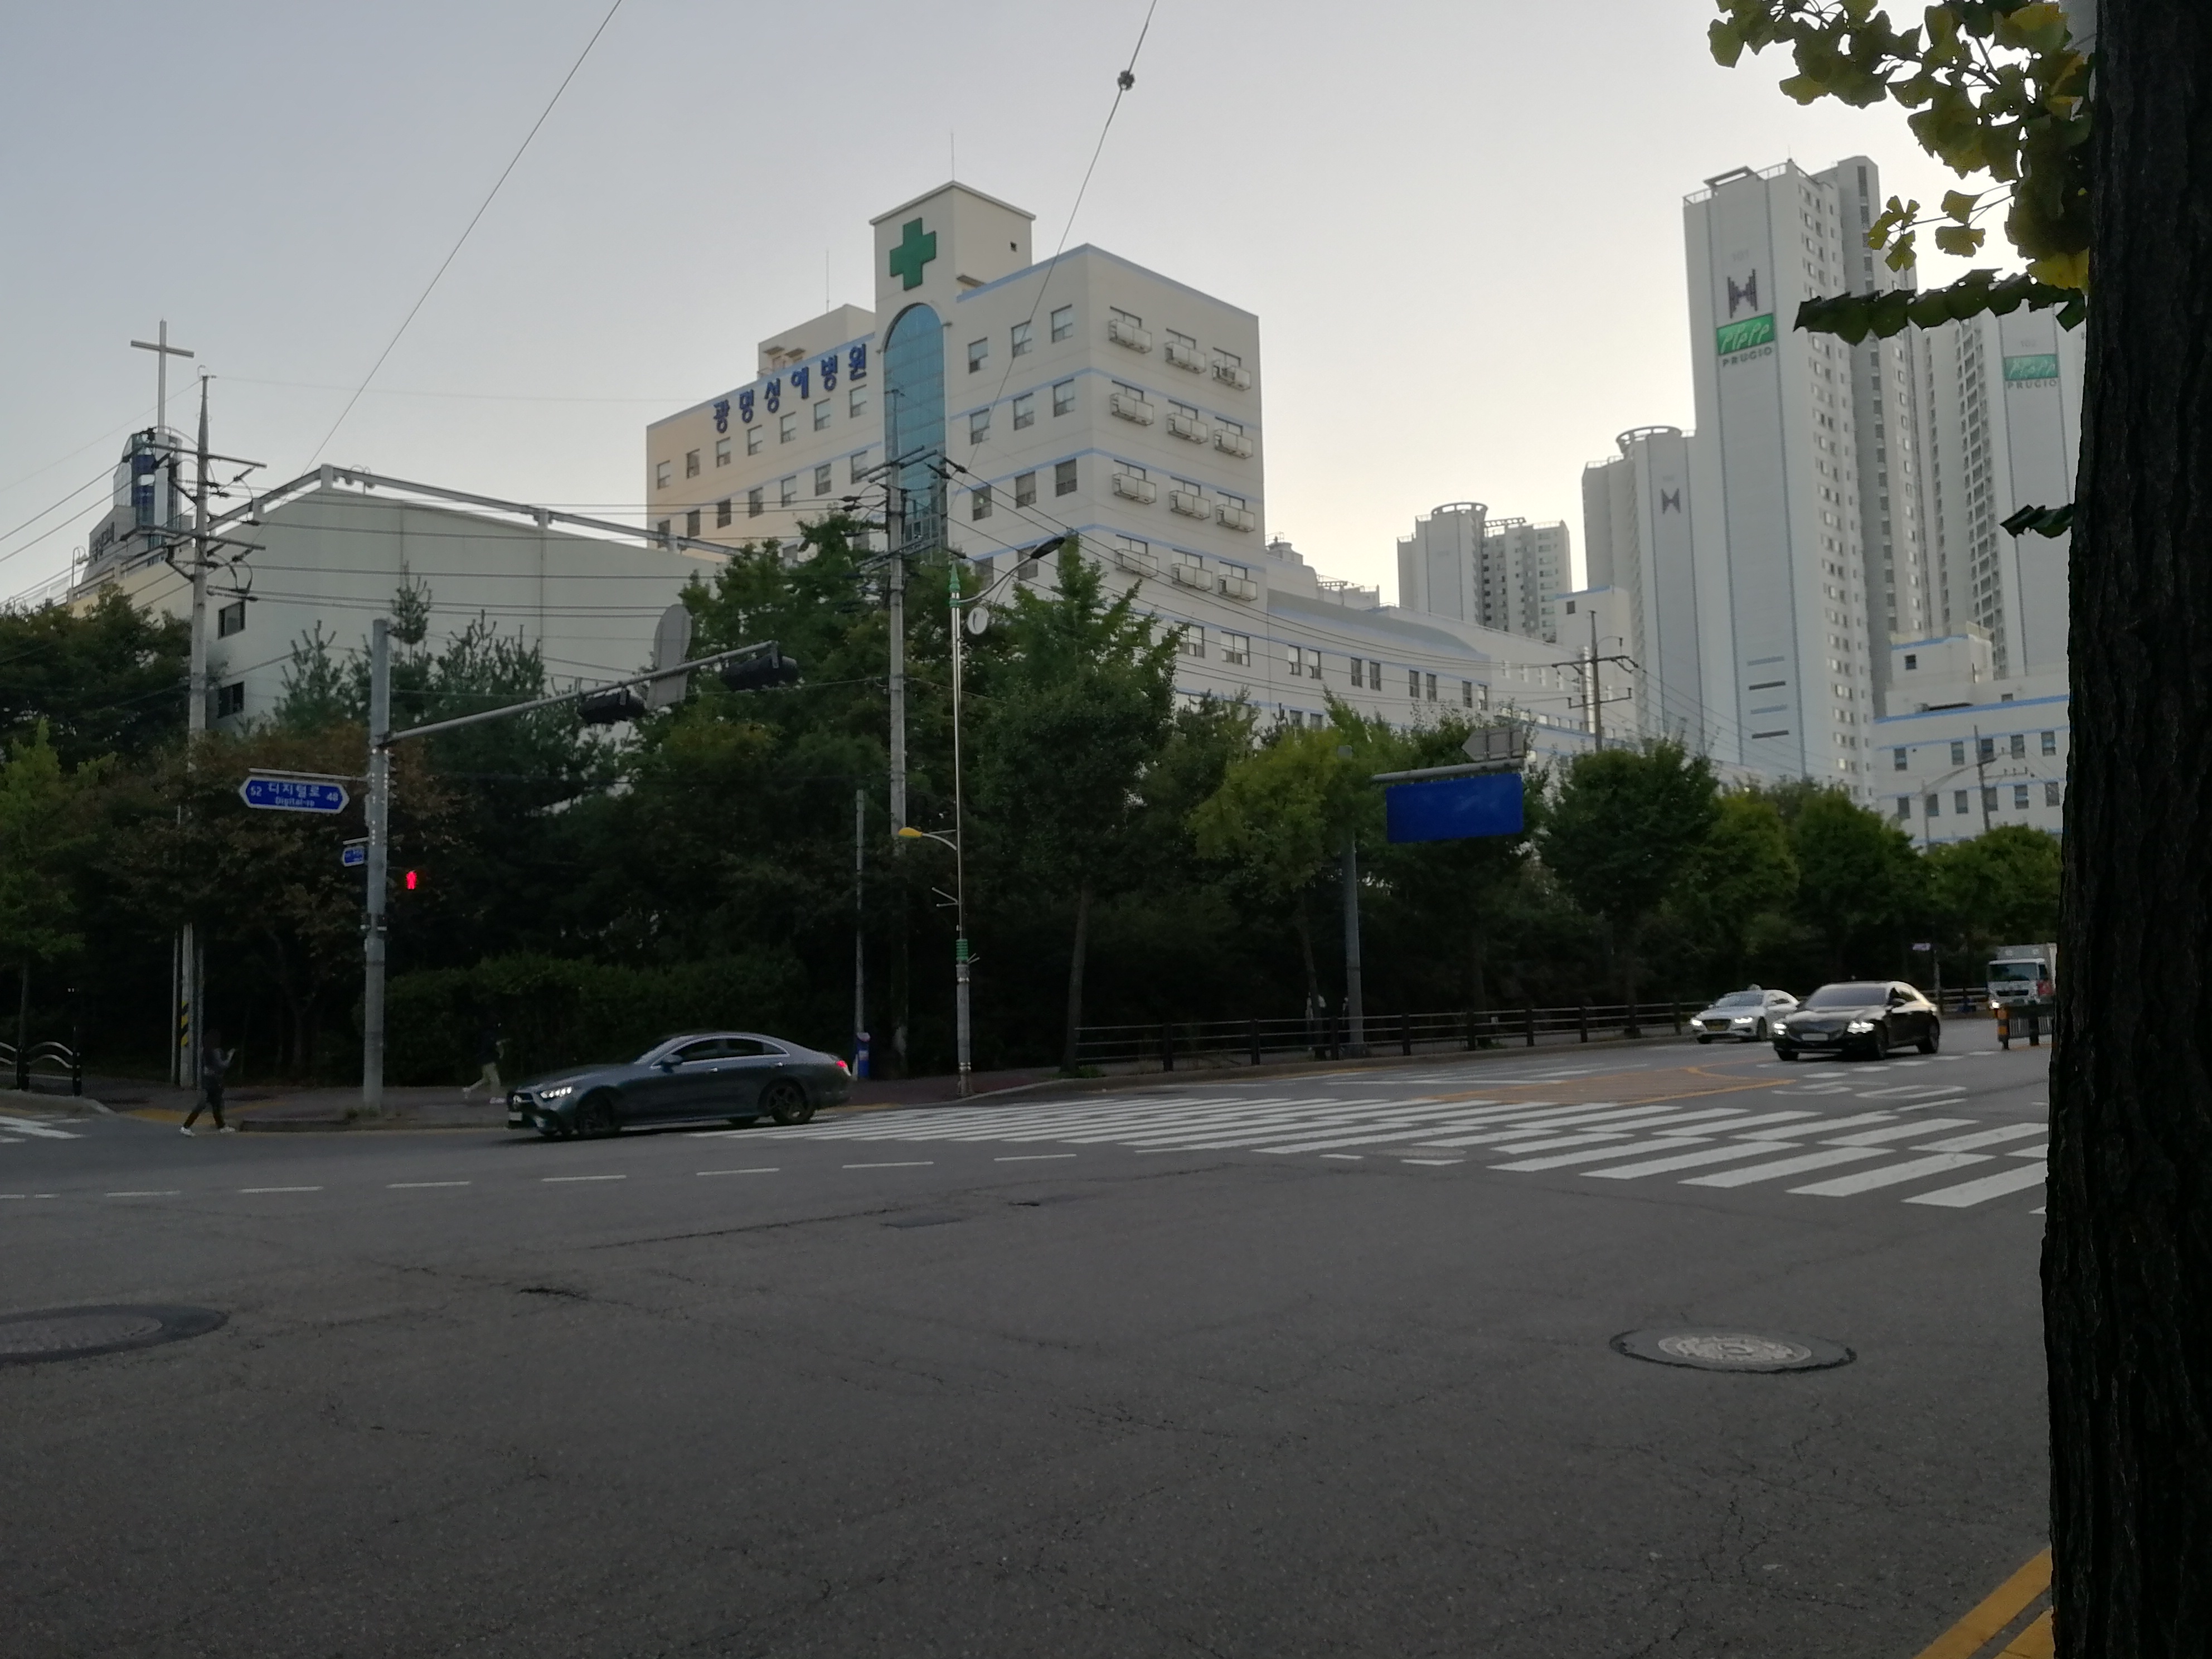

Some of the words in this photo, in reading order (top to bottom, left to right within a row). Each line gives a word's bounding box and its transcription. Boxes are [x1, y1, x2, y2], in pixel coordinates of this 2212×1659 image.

[1722, 347, 1772, 367] PRUGIO
[714, 344, 866, 433] 광명성애병원
[2007, 380, 2057, 389] PRUGIO
[268, 782, 320, 798] 디지털로
